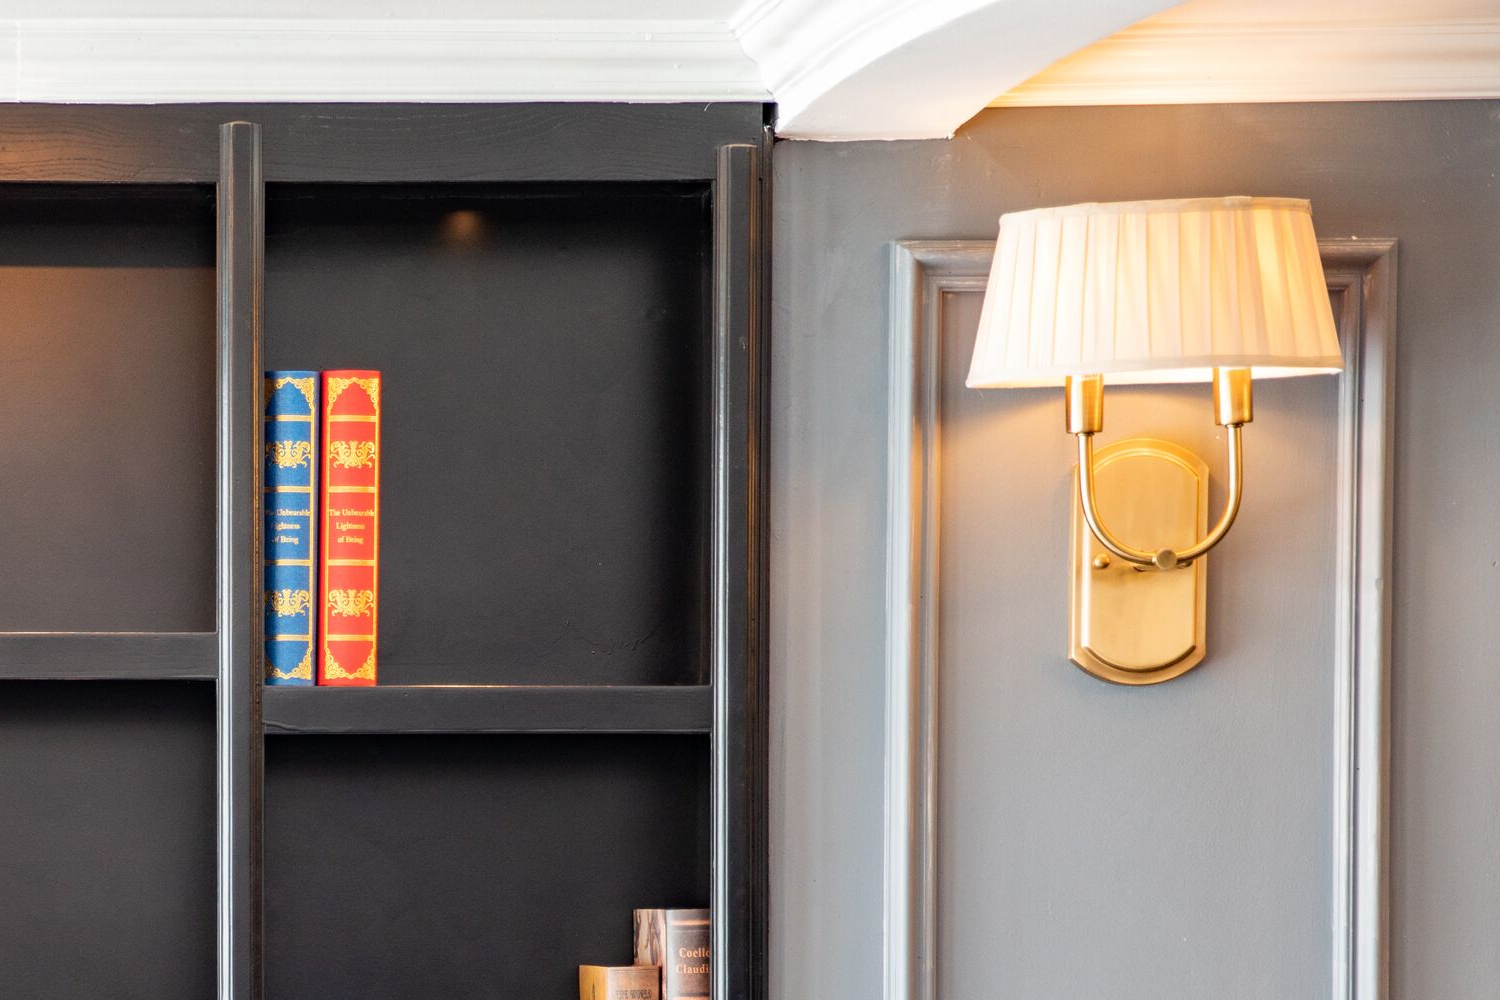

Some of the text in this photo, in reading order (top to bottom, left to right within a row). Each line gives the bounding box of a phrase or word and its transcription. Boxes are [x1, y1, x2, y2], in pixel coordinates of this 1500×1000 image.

[336, 522, 365, 531] Lightness
[280, 535, 299, 545] Being
[337, 535, 364, 545] of Being
